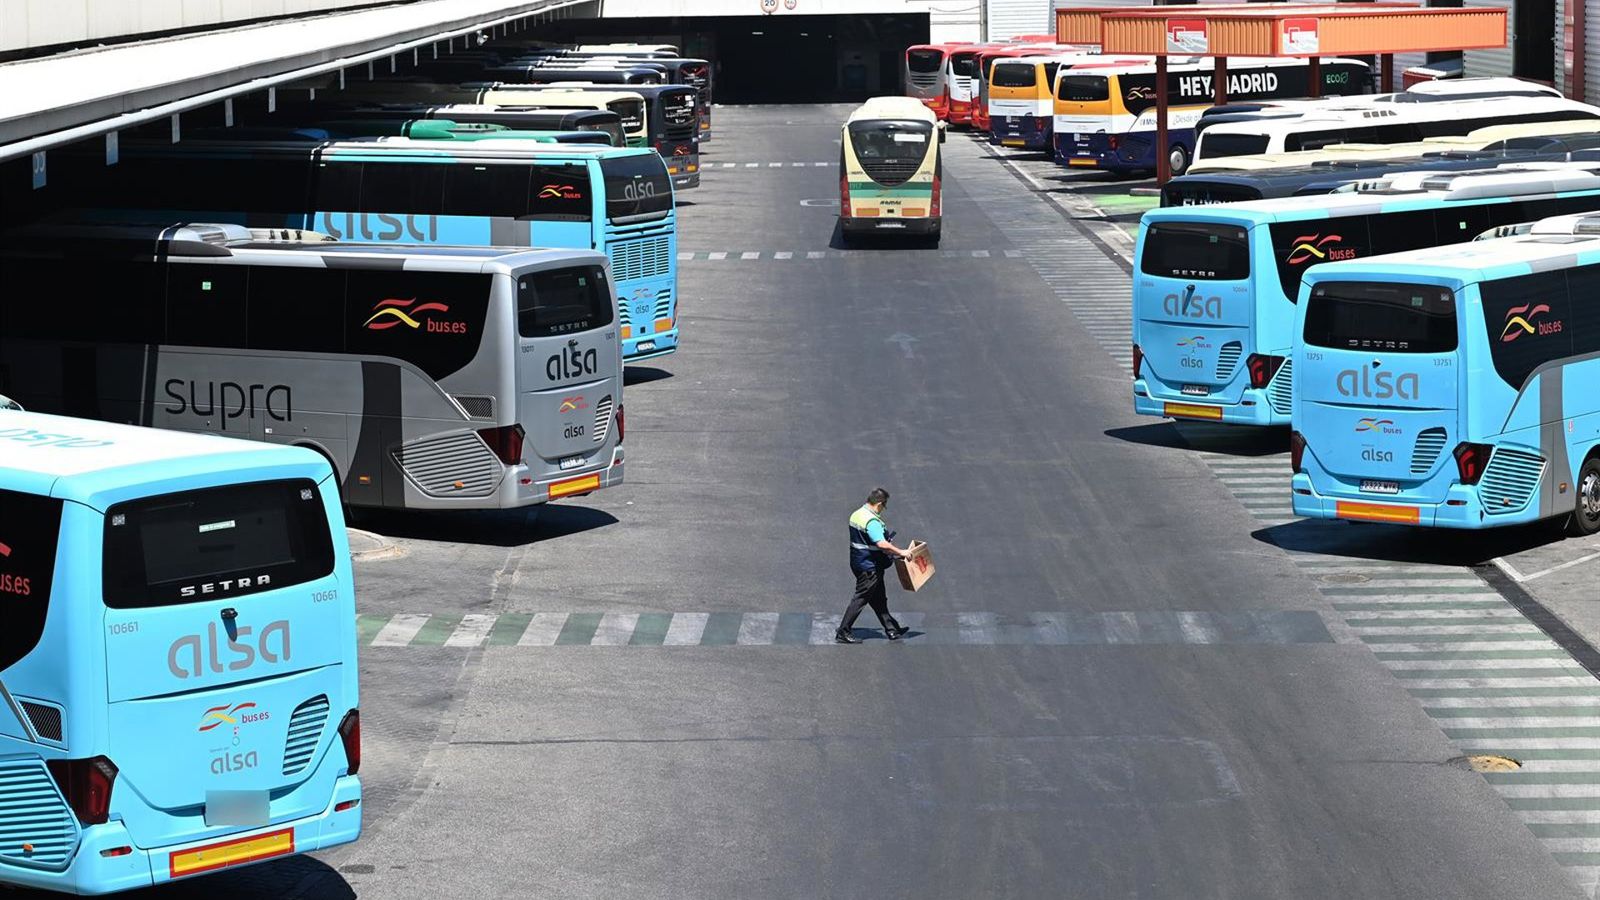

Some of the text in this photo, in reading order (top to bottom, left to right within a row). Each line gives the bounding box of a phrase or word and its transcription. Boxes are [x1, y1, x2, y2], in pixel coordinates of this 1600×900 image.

[1180, 73, 1278, 98] HEY, ADRID
[1326, 74, 1341, 84] ECO
[624, 180, 655, 201] alsa
[1172, 269, 1216, 277] SETRA
[635, 304, 650, 314] alsa
[1163, 289, 1222, 319] alsa
[427, 316, 467, 334] bus.es
[550, 321, 589, 333] SETRA
[1349, 339, 1409, 349] SETRA
[546, 347, 598, 381] alsa
[1180, 356, 1204, 369] alsa
[1306, 353, 1324, 361] 13751
[1433, 358, 1453, 367] 13751
[1336, 364, 1419, 401] alsa
[164, 378, 292, 431] supra
[564, 425, 585, 439] alsa
[1361, 448, 1394, 463] alsa
[181, 574, 271, 597] SETRA
[312, 589, 338, 603] 10661
[108, 621, 139, 635] 10661
[167, 619, 291, 679] alsa
[210, 750, 258, 775] alsa
